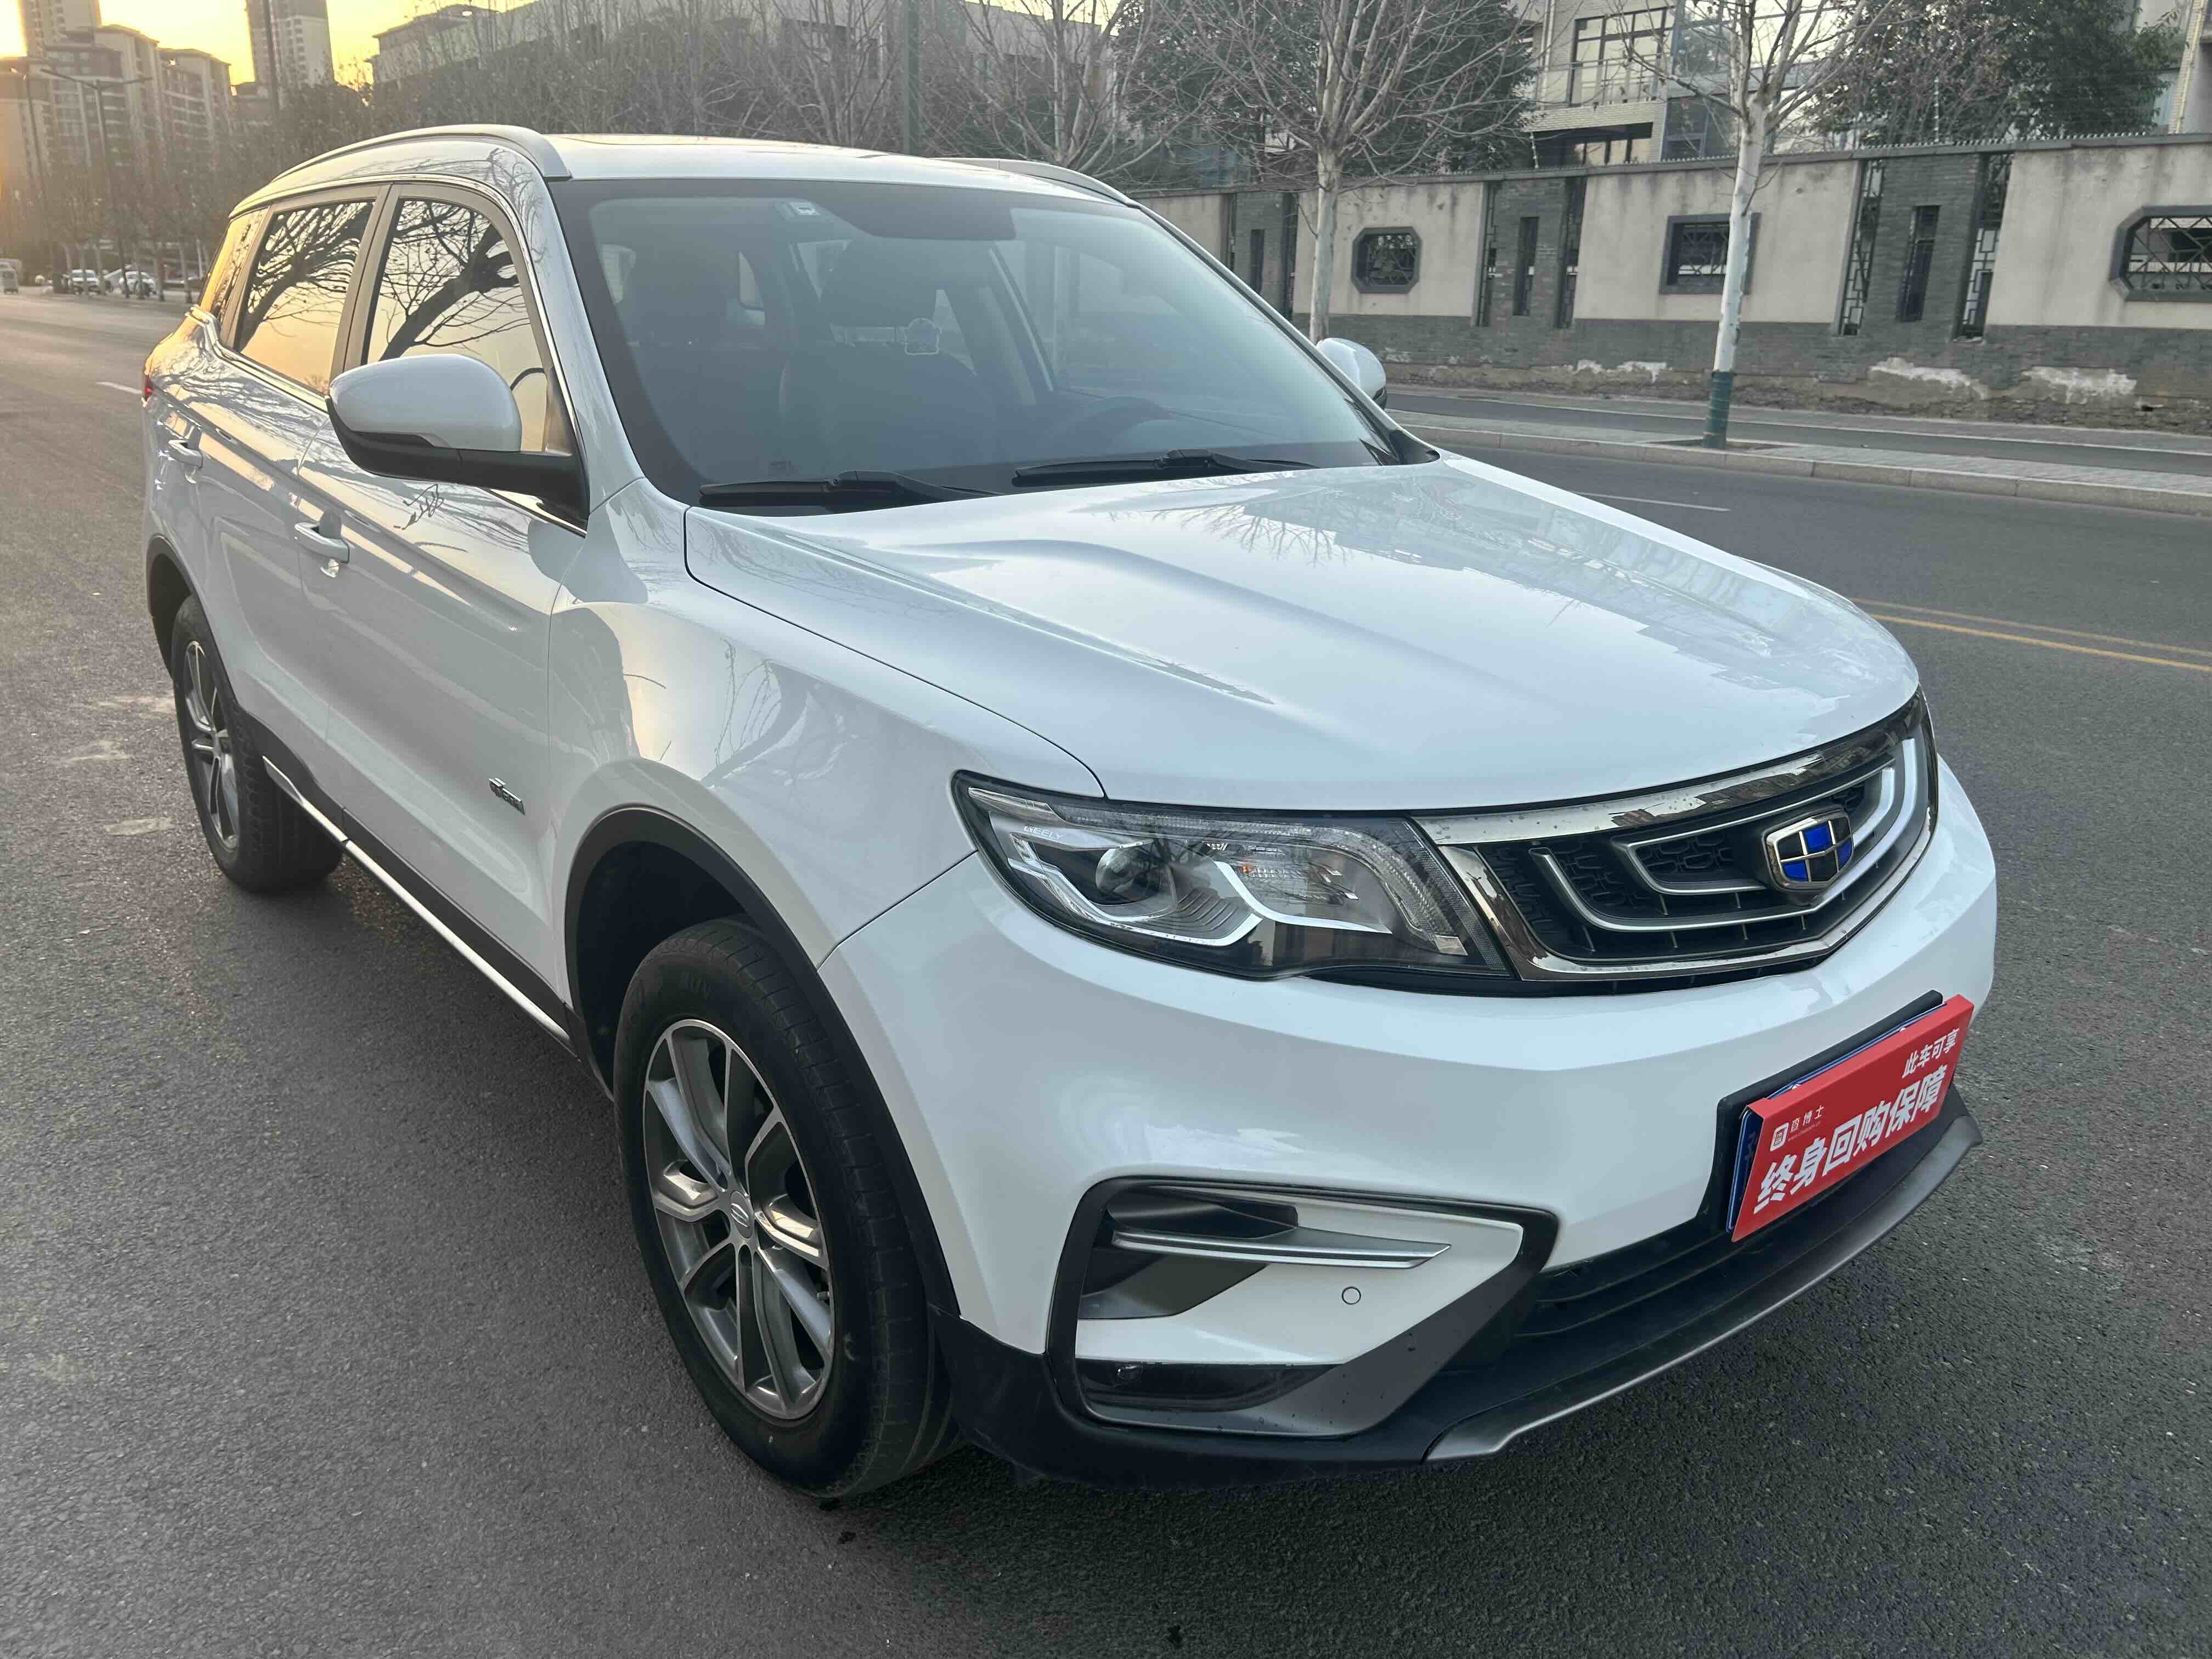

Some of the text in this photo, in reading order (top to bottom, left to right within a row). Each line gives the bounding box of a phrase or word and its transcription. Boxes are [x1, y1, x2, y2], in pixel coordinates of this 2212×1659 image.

[1023, 825, 1065, 840] GEELY
[1901, 1028, 1960, 1079] 此车可享
[1753, 1065, 1947, 1214] 终身回购保障
